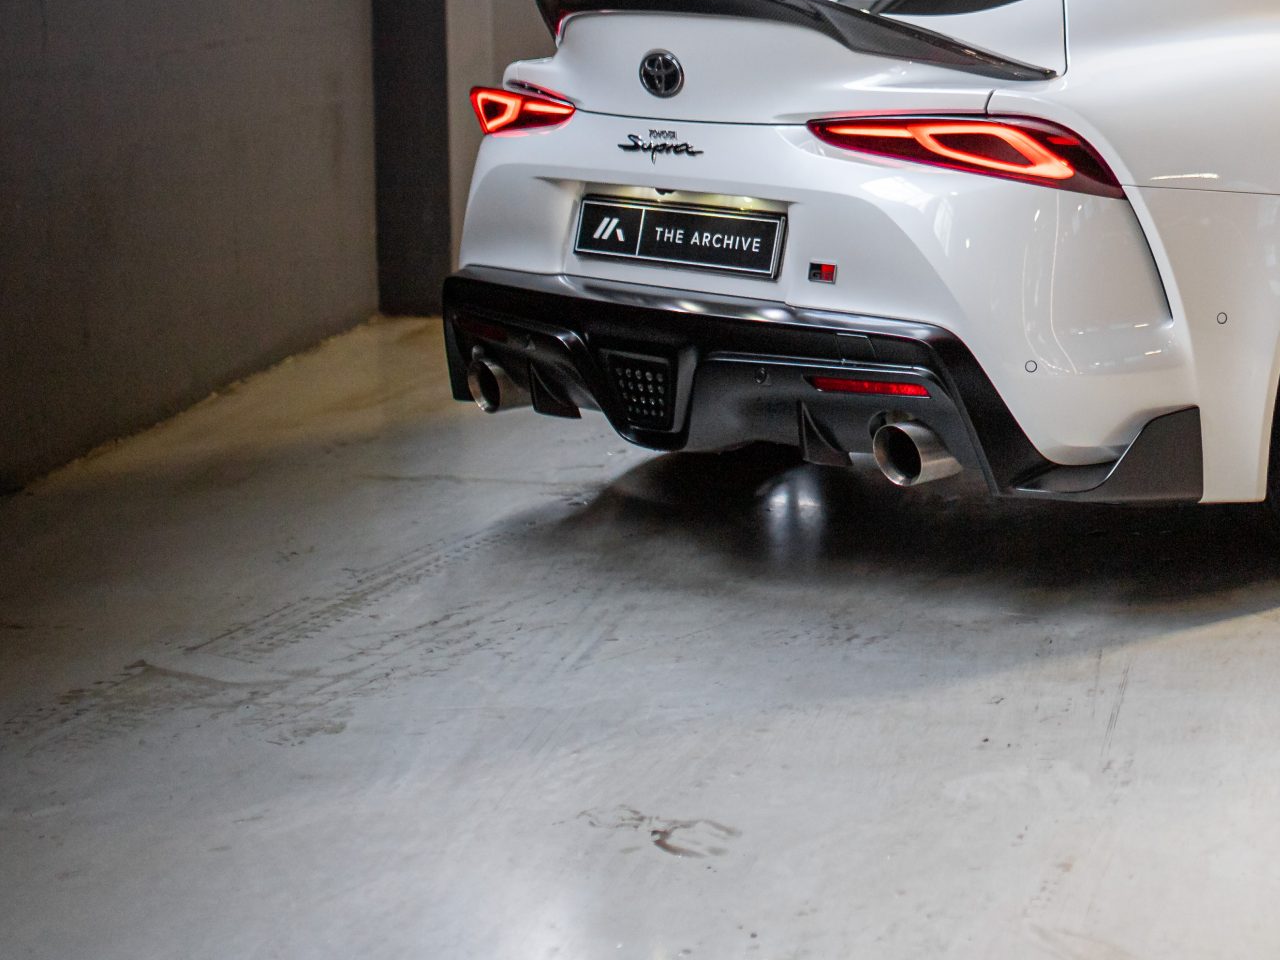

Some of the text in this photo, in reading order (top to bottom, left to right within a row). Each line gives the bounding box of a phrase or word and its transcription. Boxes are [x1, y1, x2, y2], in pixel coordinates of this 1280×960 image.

[617, 133, 704, 164] Supra
[655, 227, 762, 253] THE ARCHIVE
